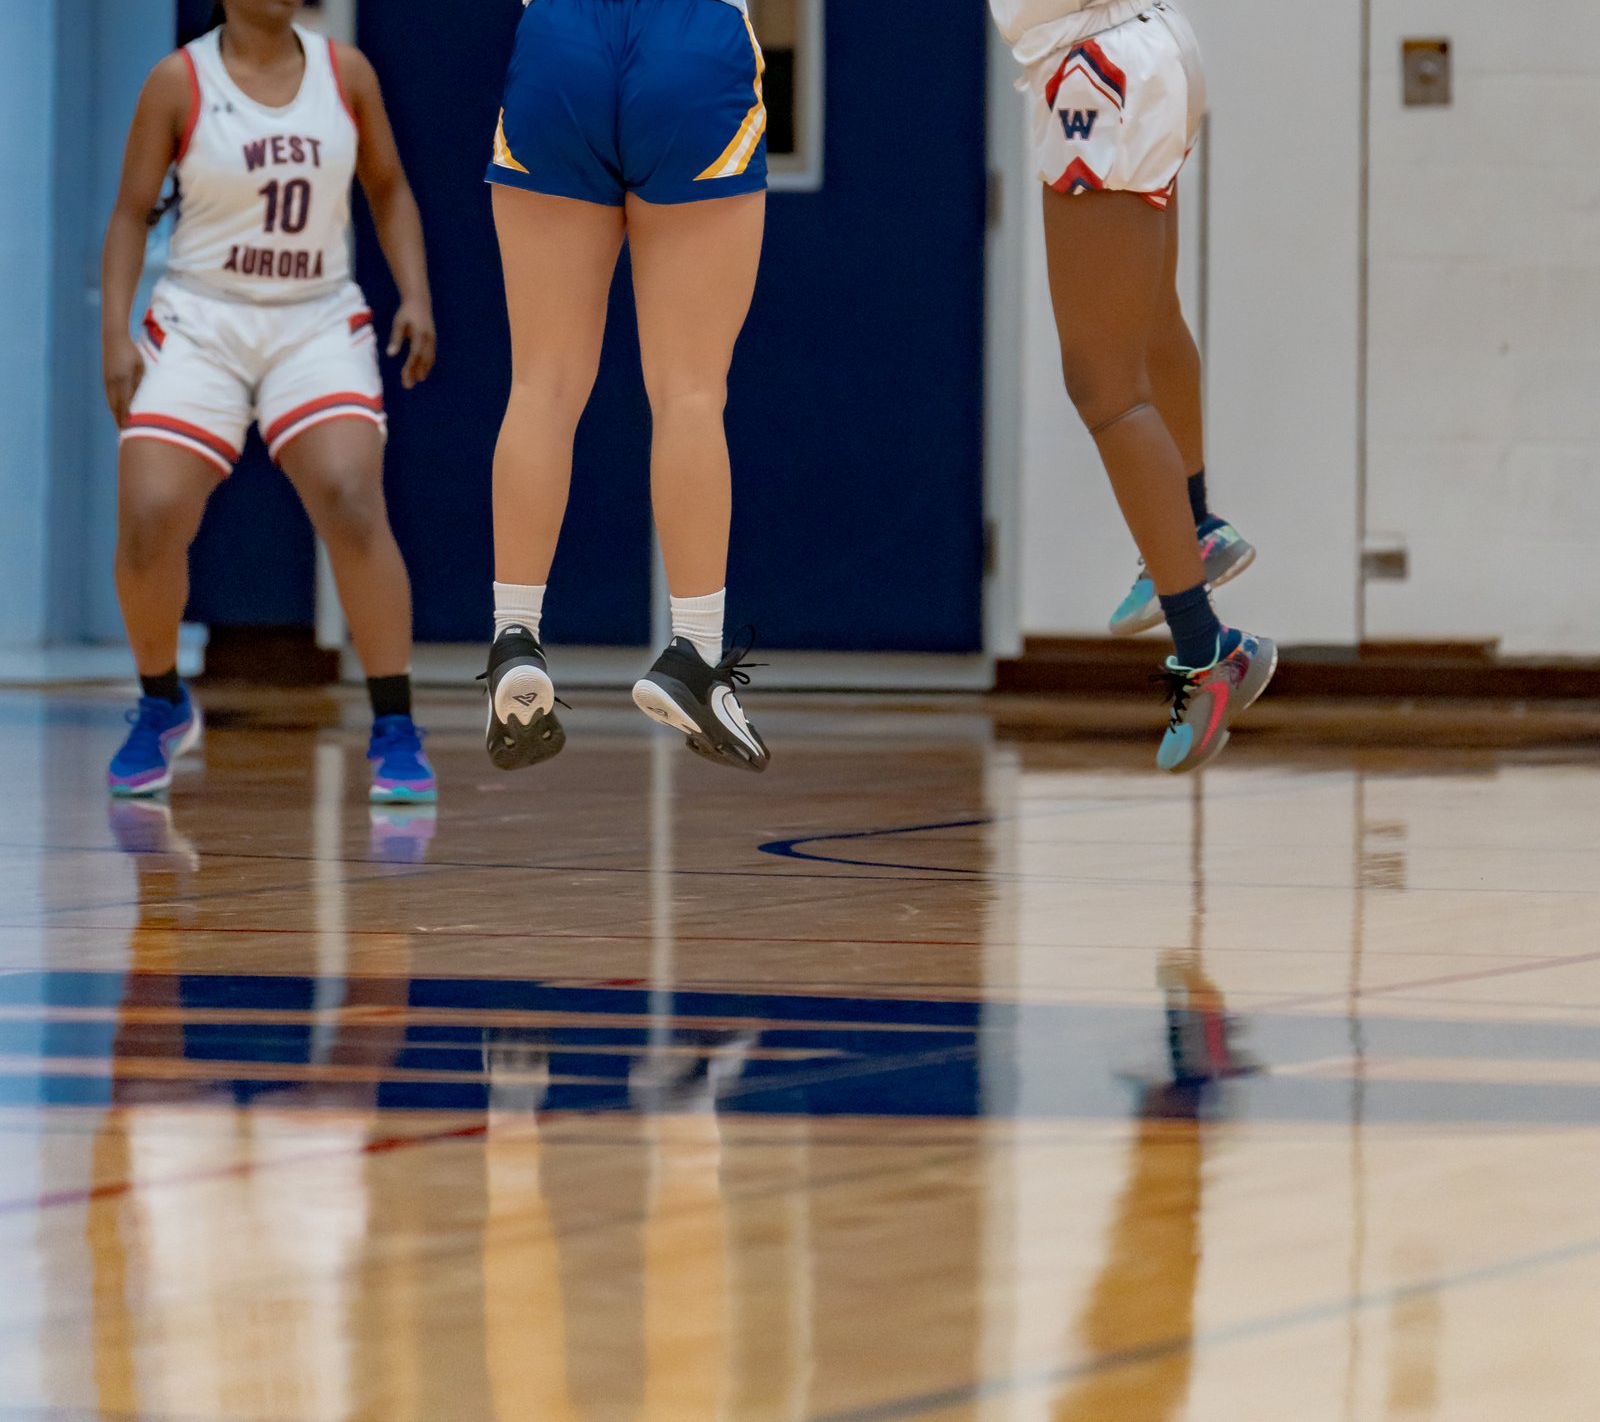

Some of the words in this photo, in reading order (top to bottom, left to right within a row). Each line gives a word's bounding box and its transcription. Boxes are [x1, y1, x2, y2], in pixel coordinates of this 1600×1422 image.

[243, 135, 322, 173] WEST
[258, 178, 311, 234] 10
[223, 244, 324, 279] AURORA
